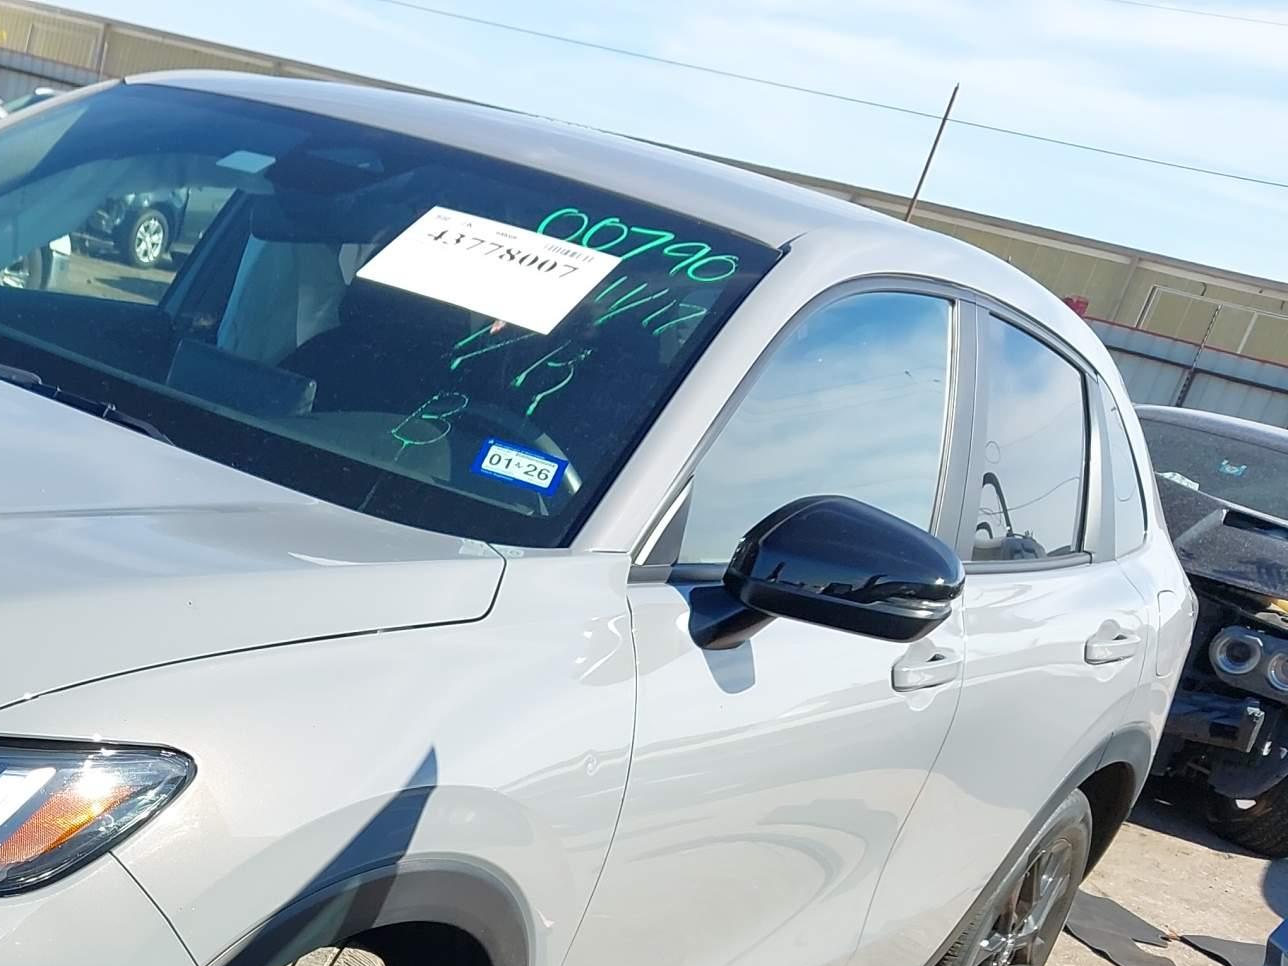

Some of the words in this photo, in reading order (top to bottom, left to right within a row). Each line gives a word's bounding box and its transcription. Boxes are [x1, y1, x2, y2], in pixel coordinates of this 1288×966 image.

[536, 207, 740, 282] 00790
[488, 453, 513, 470] 01
[523, 463, 552, 481] 26
